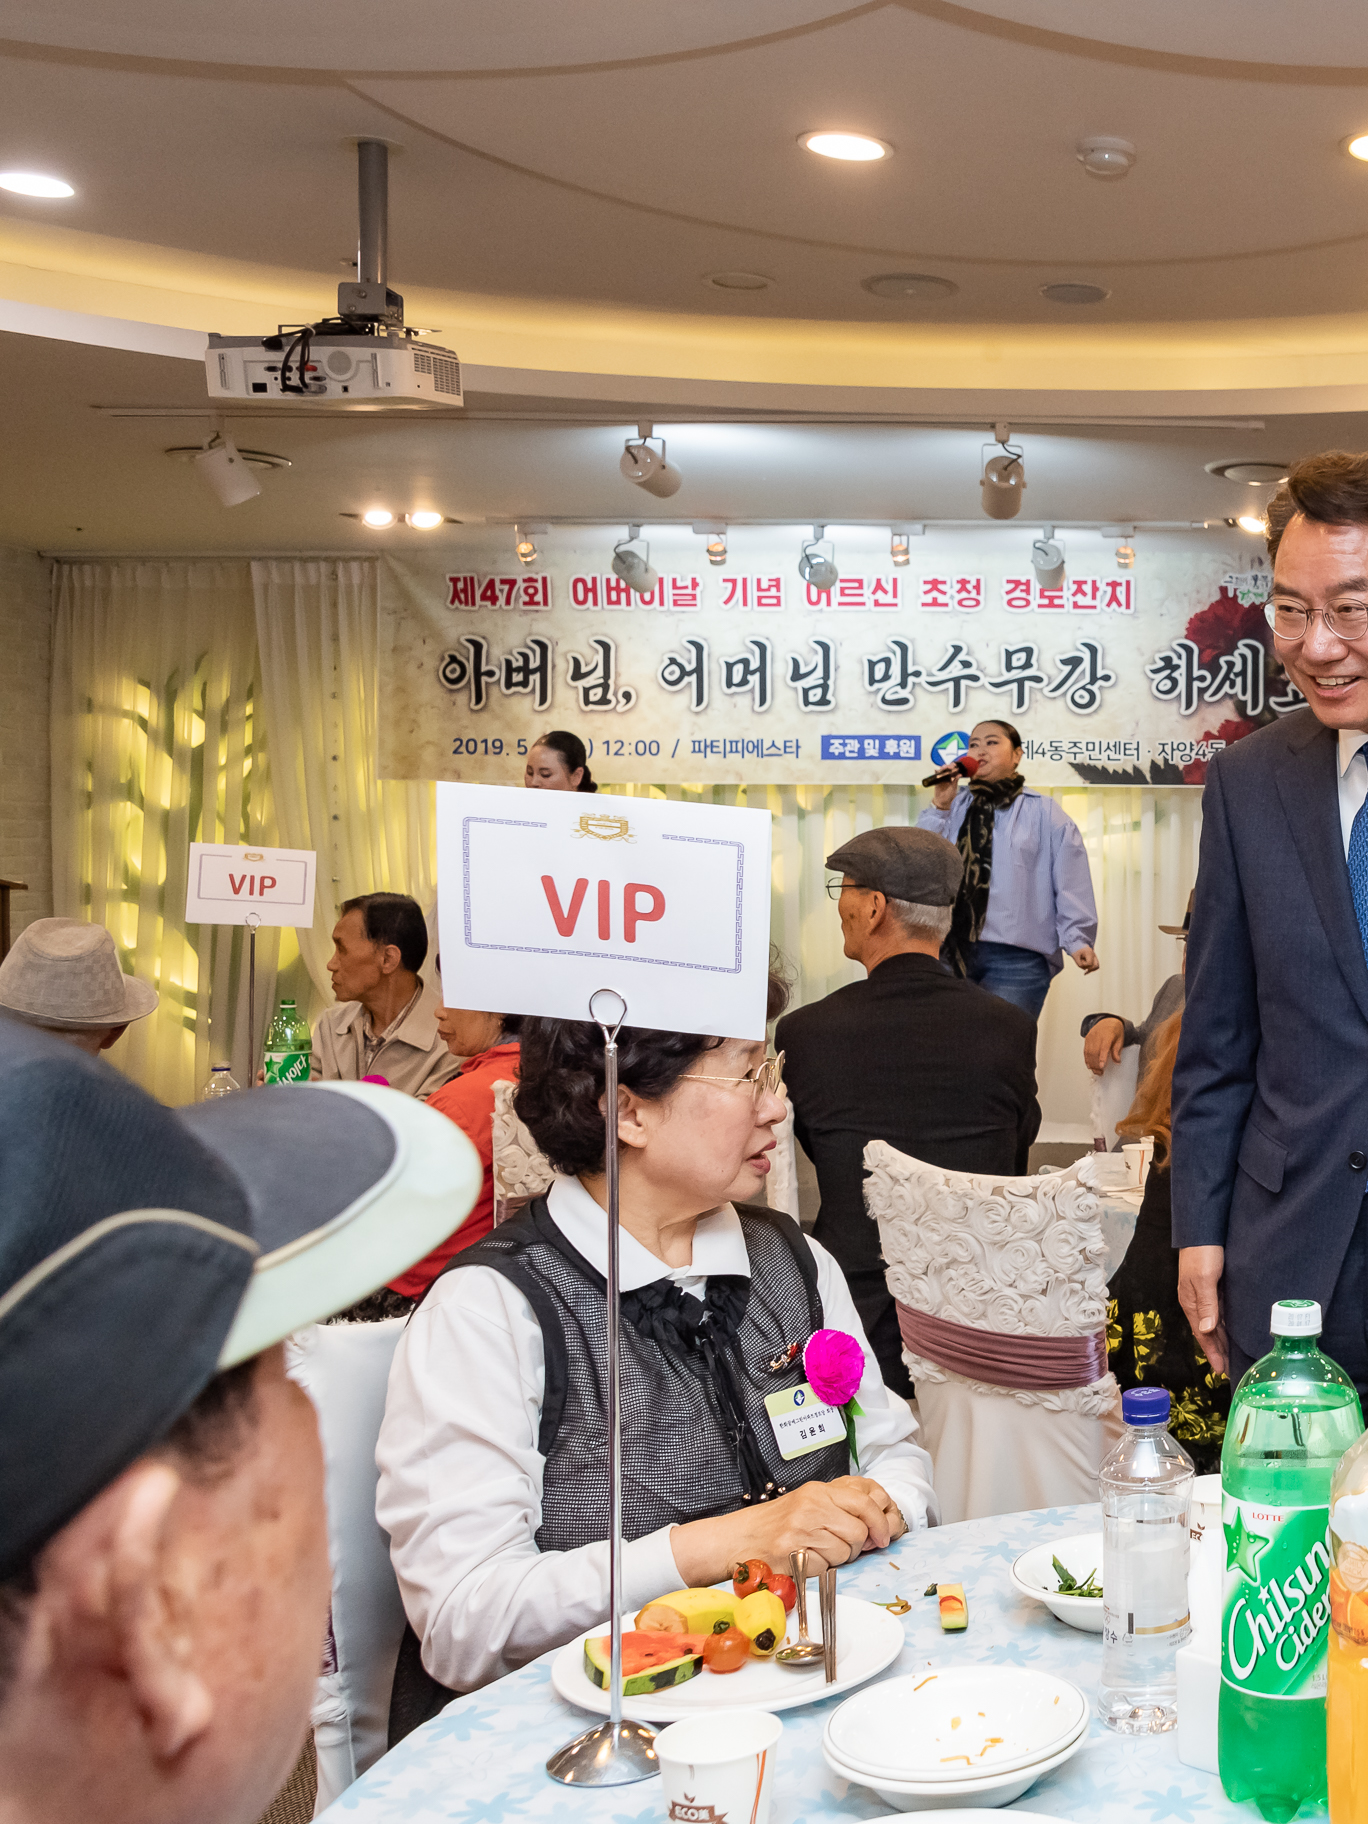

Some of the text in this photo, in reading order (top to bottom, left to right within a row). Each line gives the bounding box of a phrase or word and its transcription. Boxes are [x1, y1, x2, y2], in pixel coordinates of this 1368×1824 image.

[448, 575, 1132, 610] 제47회 어버이날 기념 어르신 초청 경로잔치
[440, 636, 634, 708] 아버님,
[661, 638, 833, 709] 어머님
[866, 639, 1112, 711] 만수무강
[602, 739, 661, 757] 12:00
[690, 739, 802, 760] 파티피에스타
[829, 739, 917, 758] 주관 및 후원
[228, 873, 277, 897] VIP
[540, 874, 666, 944] VIP
[281, 1053, 307, 1085] 사이다
[1252, 1512, 1285, 1522] LOTTE
